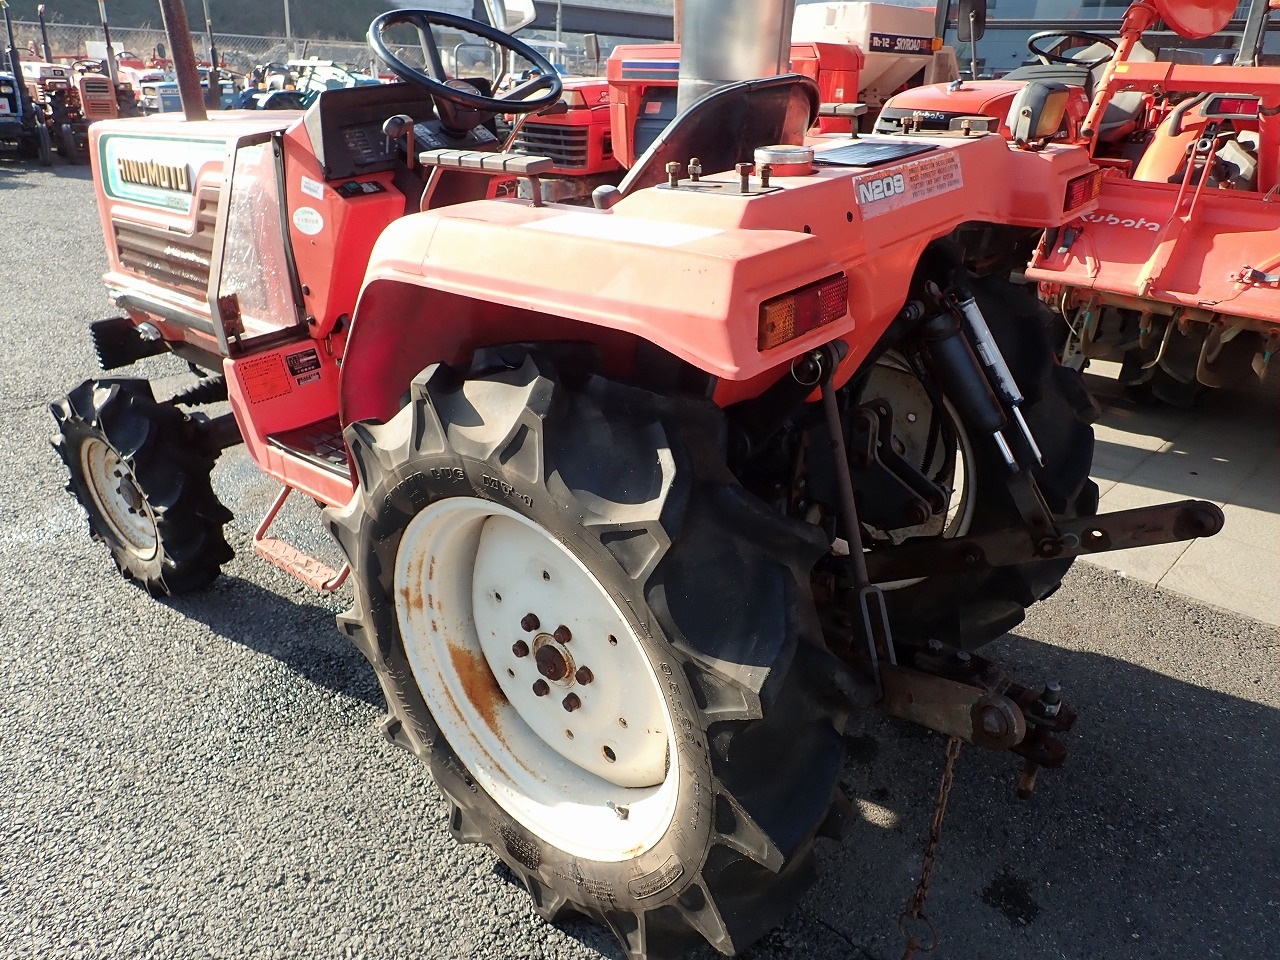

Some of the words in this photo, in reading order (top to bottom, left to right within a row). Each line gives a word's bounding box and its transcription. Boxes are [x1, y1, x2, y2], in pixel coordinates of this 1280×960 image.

[912, 111, 944, 119] Kubota
[858, 172, 905, 205] N209
[1080, 211, 1160, 231] Kubota
[430, 467, 466, 480] LUG
